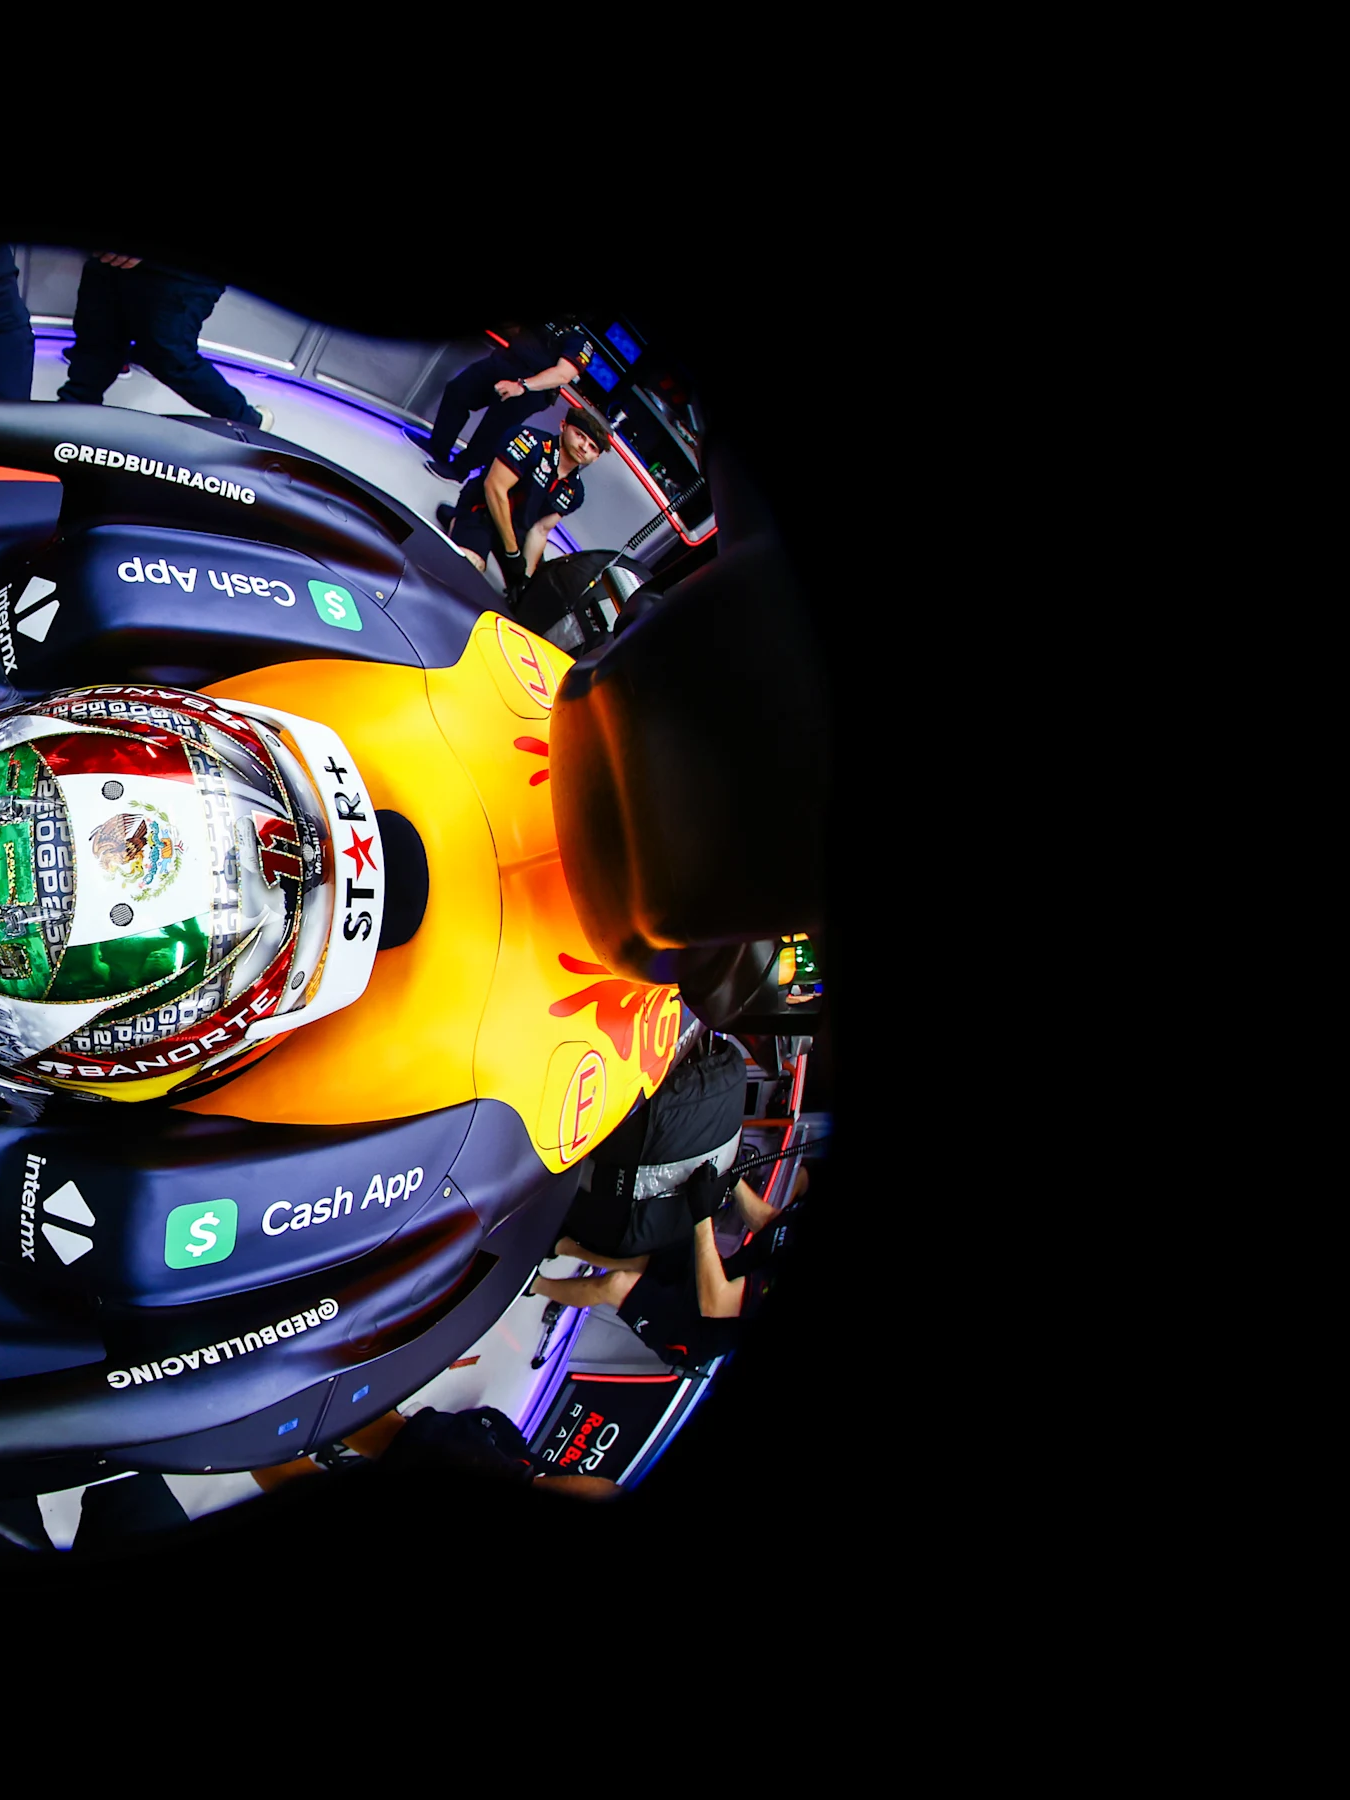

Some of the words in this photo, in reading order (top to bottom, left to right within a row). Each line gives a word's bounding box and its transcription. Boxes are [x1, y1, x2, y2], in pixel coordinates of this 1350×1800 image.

[54, 442, 257, 505] @REDBULLRACING
[117, 557, 199, 593] App
[208, 570, 297, 608] Cash
[252, 810, 302, 890] 11
[66, 987, 279, 1079] BANORTE
[20, 1153, 46, 1262] inter.mx
[261, 1186, 355, 1236] Cash
[361, 1166, 424, 1209] App
[107, 1298, 340, 1389] @REDBULLRACING
